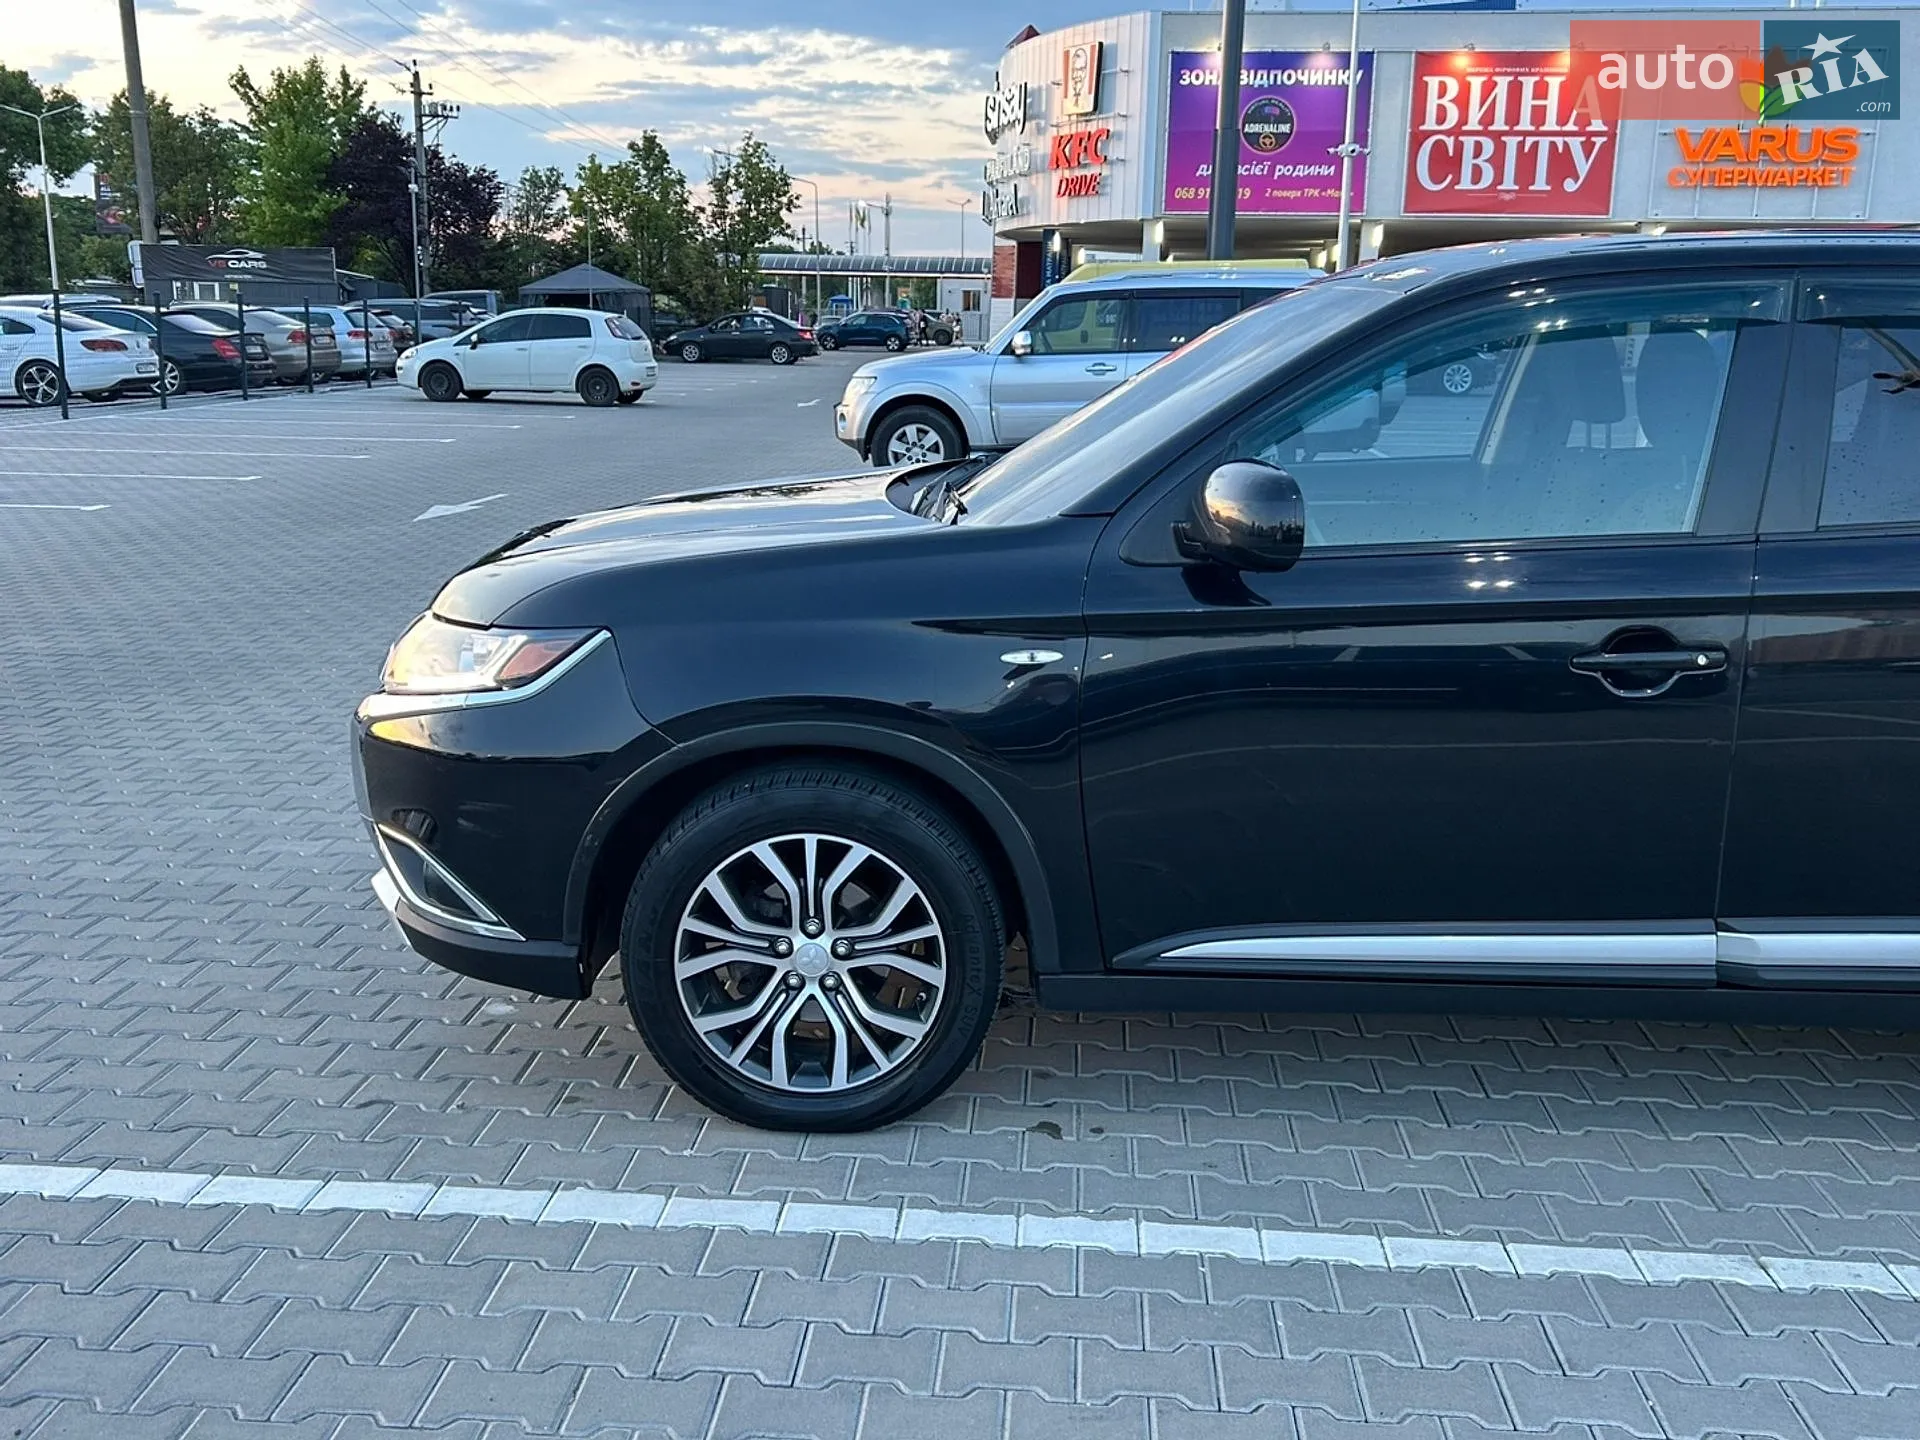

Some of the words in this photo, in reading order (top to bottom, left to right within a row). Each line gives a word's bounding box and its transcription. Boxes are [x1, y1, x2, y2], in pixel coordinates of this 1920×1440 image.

[1179, 68, 1222, 86] ЗОН
[1419, 75, 1609, 131] ВИНА
[1244, 123, 1291, 134] ADRENALINE
[1048, 127, 1111, 170] KFC
[1673, 126, 1861, 163] VARUS
[1274, 164, 1335, 180] родини
[1416, 134, 1608, 192] СВІТУ
[1056, 173, 1101, 199] DRIVE
[1666, 166, 1857, 187] СУПЕРМАРКЕТ
[1174, 186, 1196, 199] 068
[1265, 188, 1272, 197] 2
[1303, 188, 1321, 198] ТРК
